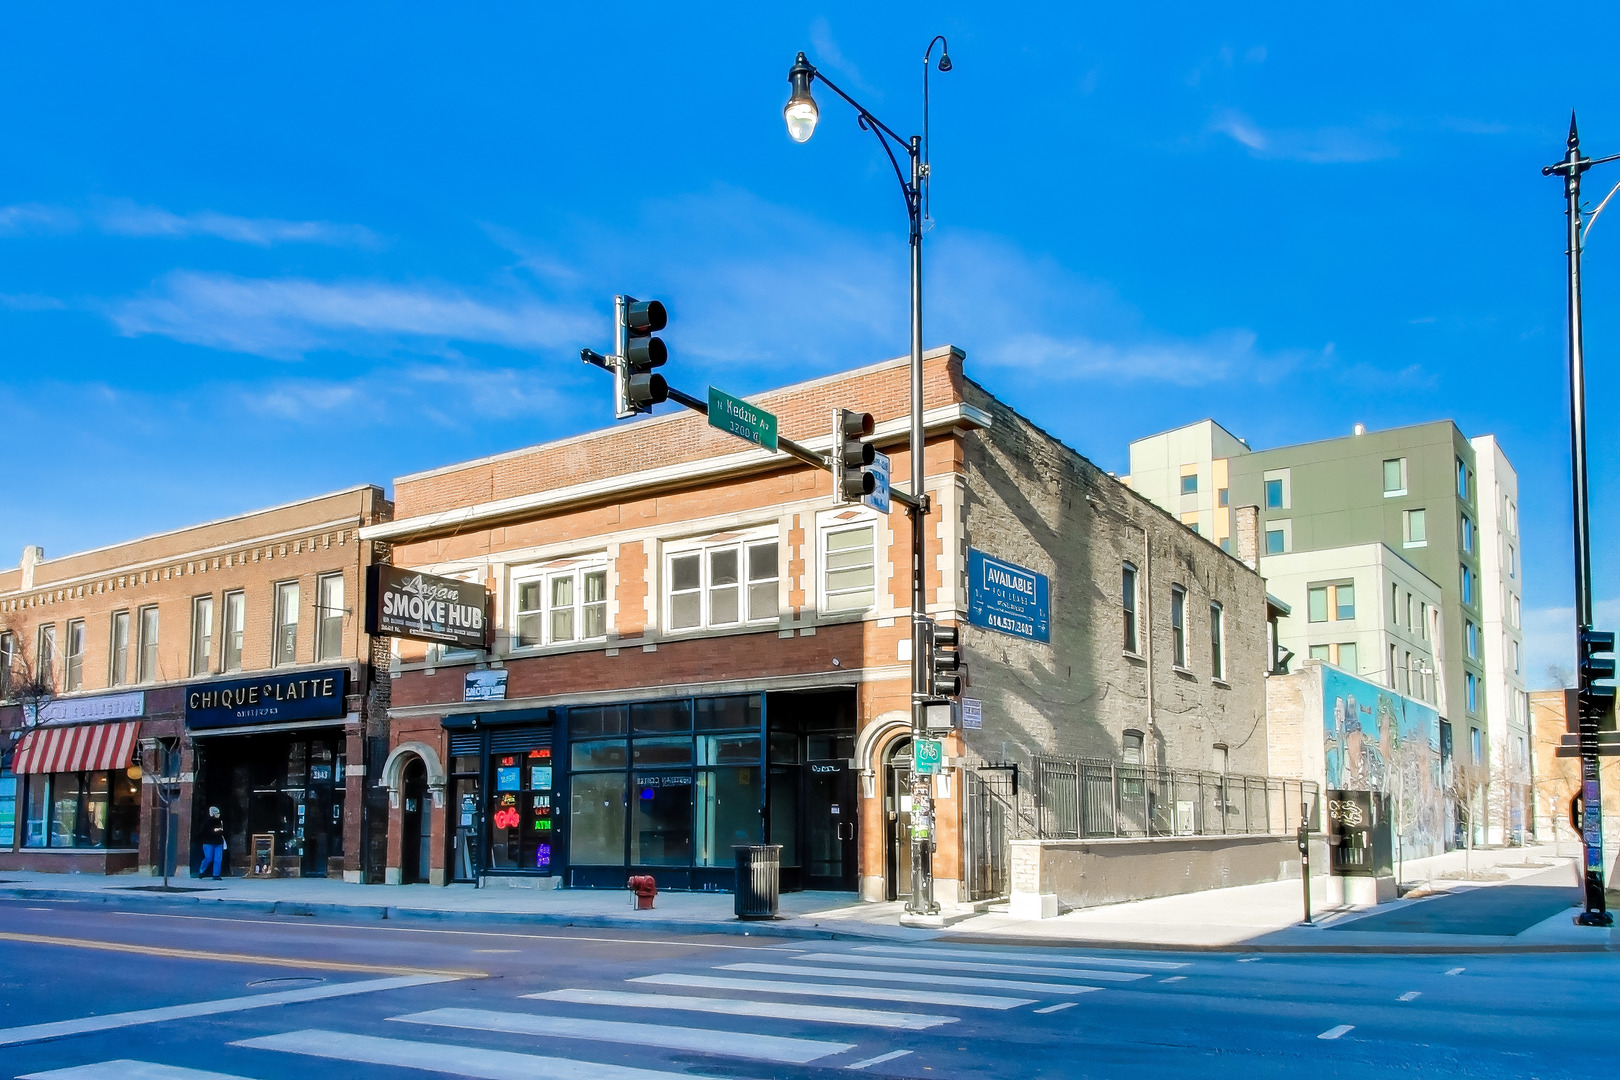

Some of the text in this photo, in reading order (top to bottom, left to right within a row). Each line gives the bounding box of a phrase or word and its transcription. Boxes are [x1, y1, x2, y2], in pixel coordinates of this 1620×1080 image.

[726, 399, 757, 425] Kedzie
[729, 420, 750, 438] 3200
[988, 567, 1033, 595] AVAILABLE
[383, 591, 445, 623] SMOKE
[448, 602, 482, 629] HUB
[190, 686, 258, 709] CHIQUE
[275, 678, 334, 701] LATTE
[534, 820, 551, 830] ATM
